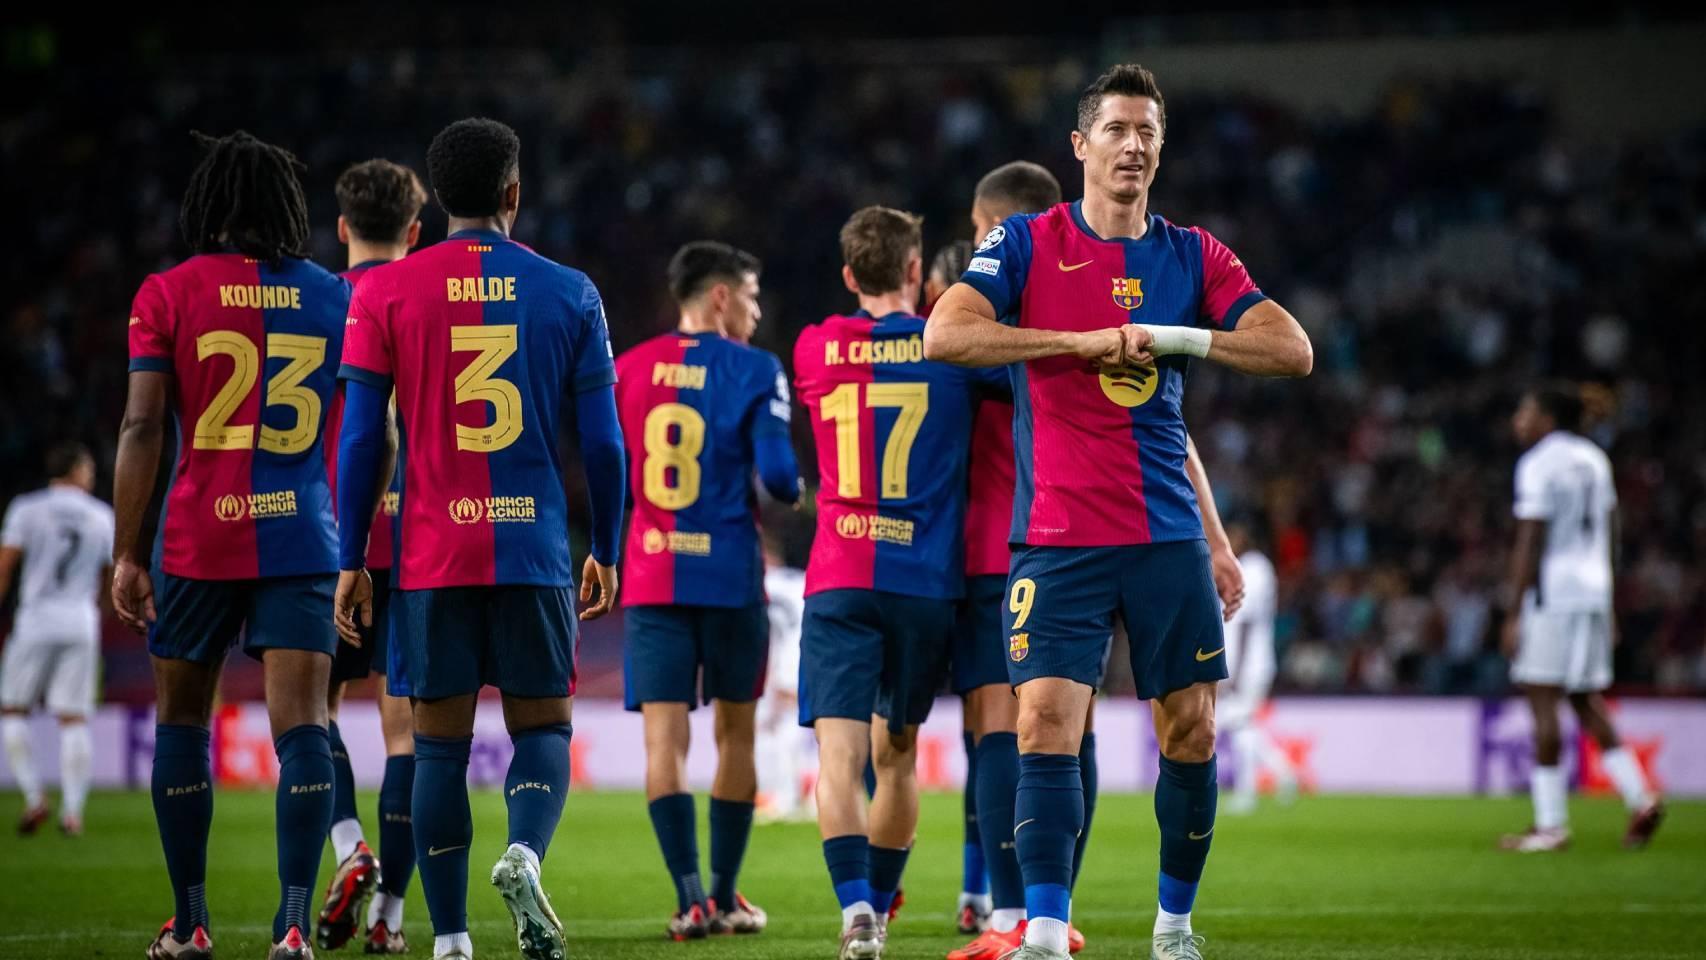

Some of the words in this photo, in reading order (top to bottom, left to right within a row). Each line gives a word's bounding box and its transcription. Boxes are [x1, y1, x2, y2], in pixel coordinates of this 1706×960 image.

[220, 285, 301, 309] KOUNDE
[447, 277, 516, 302] BALDE
[848, 333, 922, 364] CASADÓ
[451, 324, 524, 452] 3
[652, 362, 707, 390] PEDRI
[193, 330, 327, 455] 23
[820, 382, 929, 499] 17
[643, 402, 706, 511] 8
[247, 490, 296, 504] UNHCR
[249, 501, 297, 514] ACNUR
[485, 496, 535, 508] UNHCR
[486, 507, 536, 518] ACNUR
[1009, 578, 1036, 630] 9
